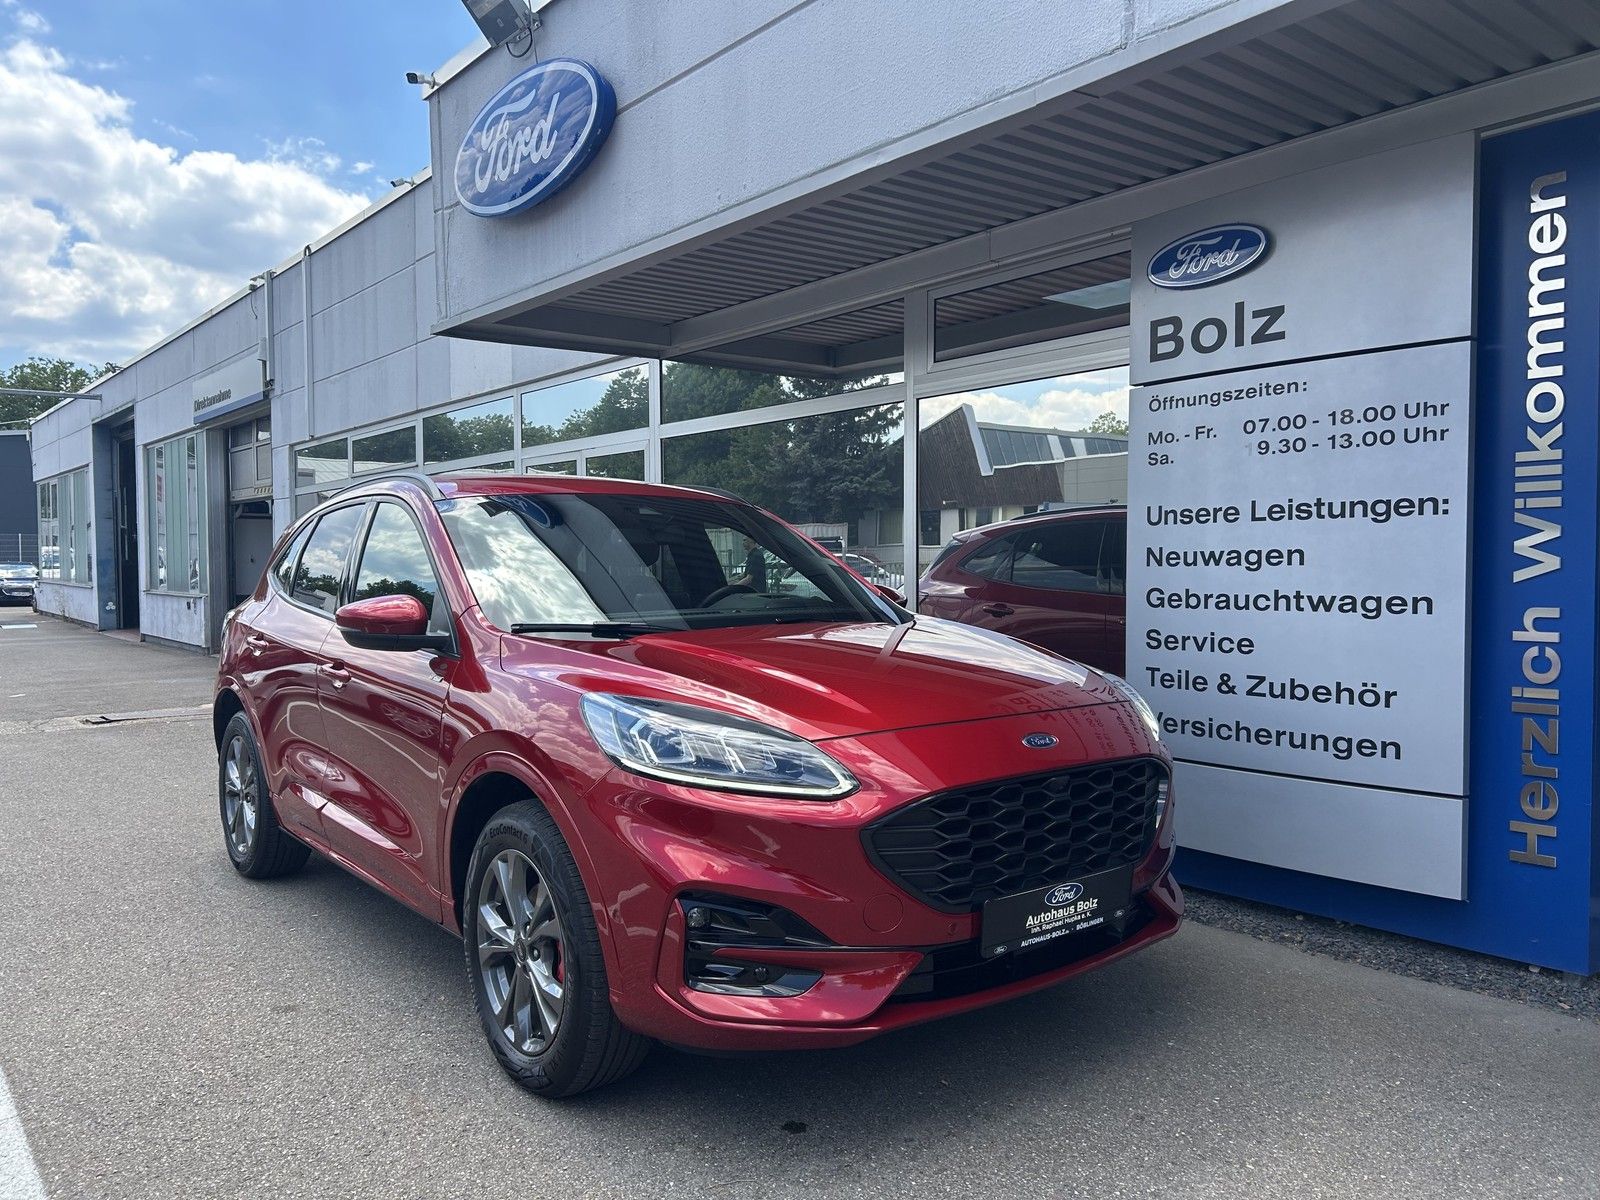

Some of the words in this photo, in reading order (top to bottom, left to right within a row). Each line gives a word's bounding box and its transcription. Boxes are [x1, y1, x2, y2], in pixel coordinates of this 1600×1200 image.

[474, 88, 560, 193] Ford
[1168, 236, 1240, 279] Ford
[1148, 301, 1286, 363] Bolz
[1513, 170, 1568, 583] Willkommen
[1148, 380, 1309, 413] Öffnungszeiten:
[1148, 430, 1180, 446] Mo.
[1195, 425, 1217, 440] Fr.
[1243, 413, 1307, 436] 07.00
[1327, 405, 1397, 428] 18.00
[1403, 400, 1450, 420] Uhr
[1148, 452, 1174, 466] Sa.
[1257, 438, 1307, 457] 9.30
[1327, 429, 1397, 451] 13.00
[1403, 425, 1450, 445] Uhr
[1146, 505, 1240, 526] Unsere
[1250, 496, 1450, 523] Leistungen:
[1145, 546, 1305, 572] Neuwagen
[1145, 587, 1434, 620] Gebrauchtwagen
[1145, 629, 1255, 655] Service
[1145, 666, 1208, 692] Teile
[1216, 674, 1237, 696] &
[1245, 674, 1398, 709] Zubehör
[1030, 735, 1051, 746] Ford
[1509, 606, 1562, 868] Herzlich
[490, 823, 522, 840] EcoContact
[1051, 886, 1076, 904] Ford
[1026, 905, 1075, 927] Autohaus
[1077, 898, 1098, 912] Bolz
[1042, 919, 1063, 930] Raphael
